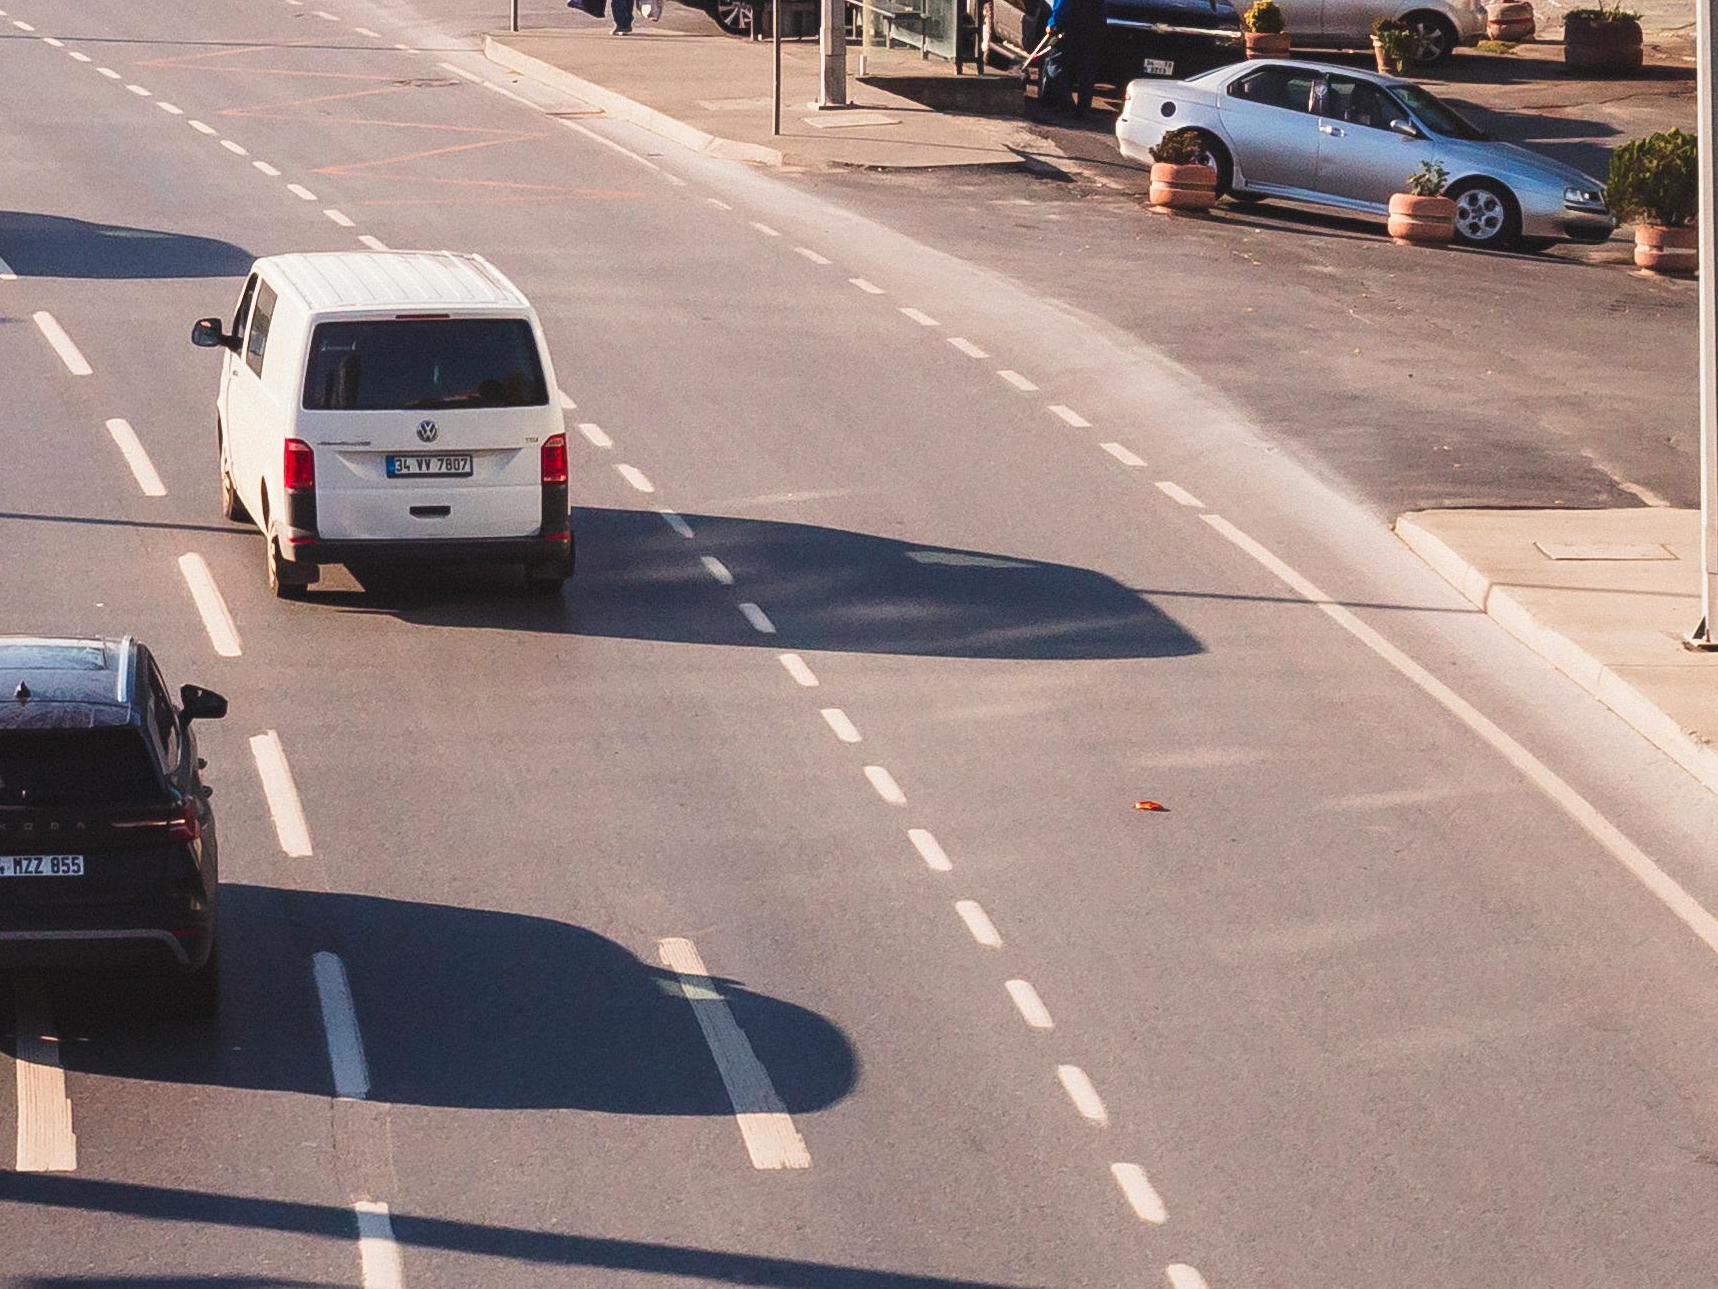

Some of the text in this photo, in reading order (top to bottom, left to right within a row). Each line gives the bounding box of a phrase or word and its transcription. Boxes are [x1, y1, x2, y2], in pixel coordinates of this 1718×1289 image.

[395, 458, 468, 472] 34 VV 7807
[14, 858, 43, 874] MZZ
[51, 857, 82, 874] 855
